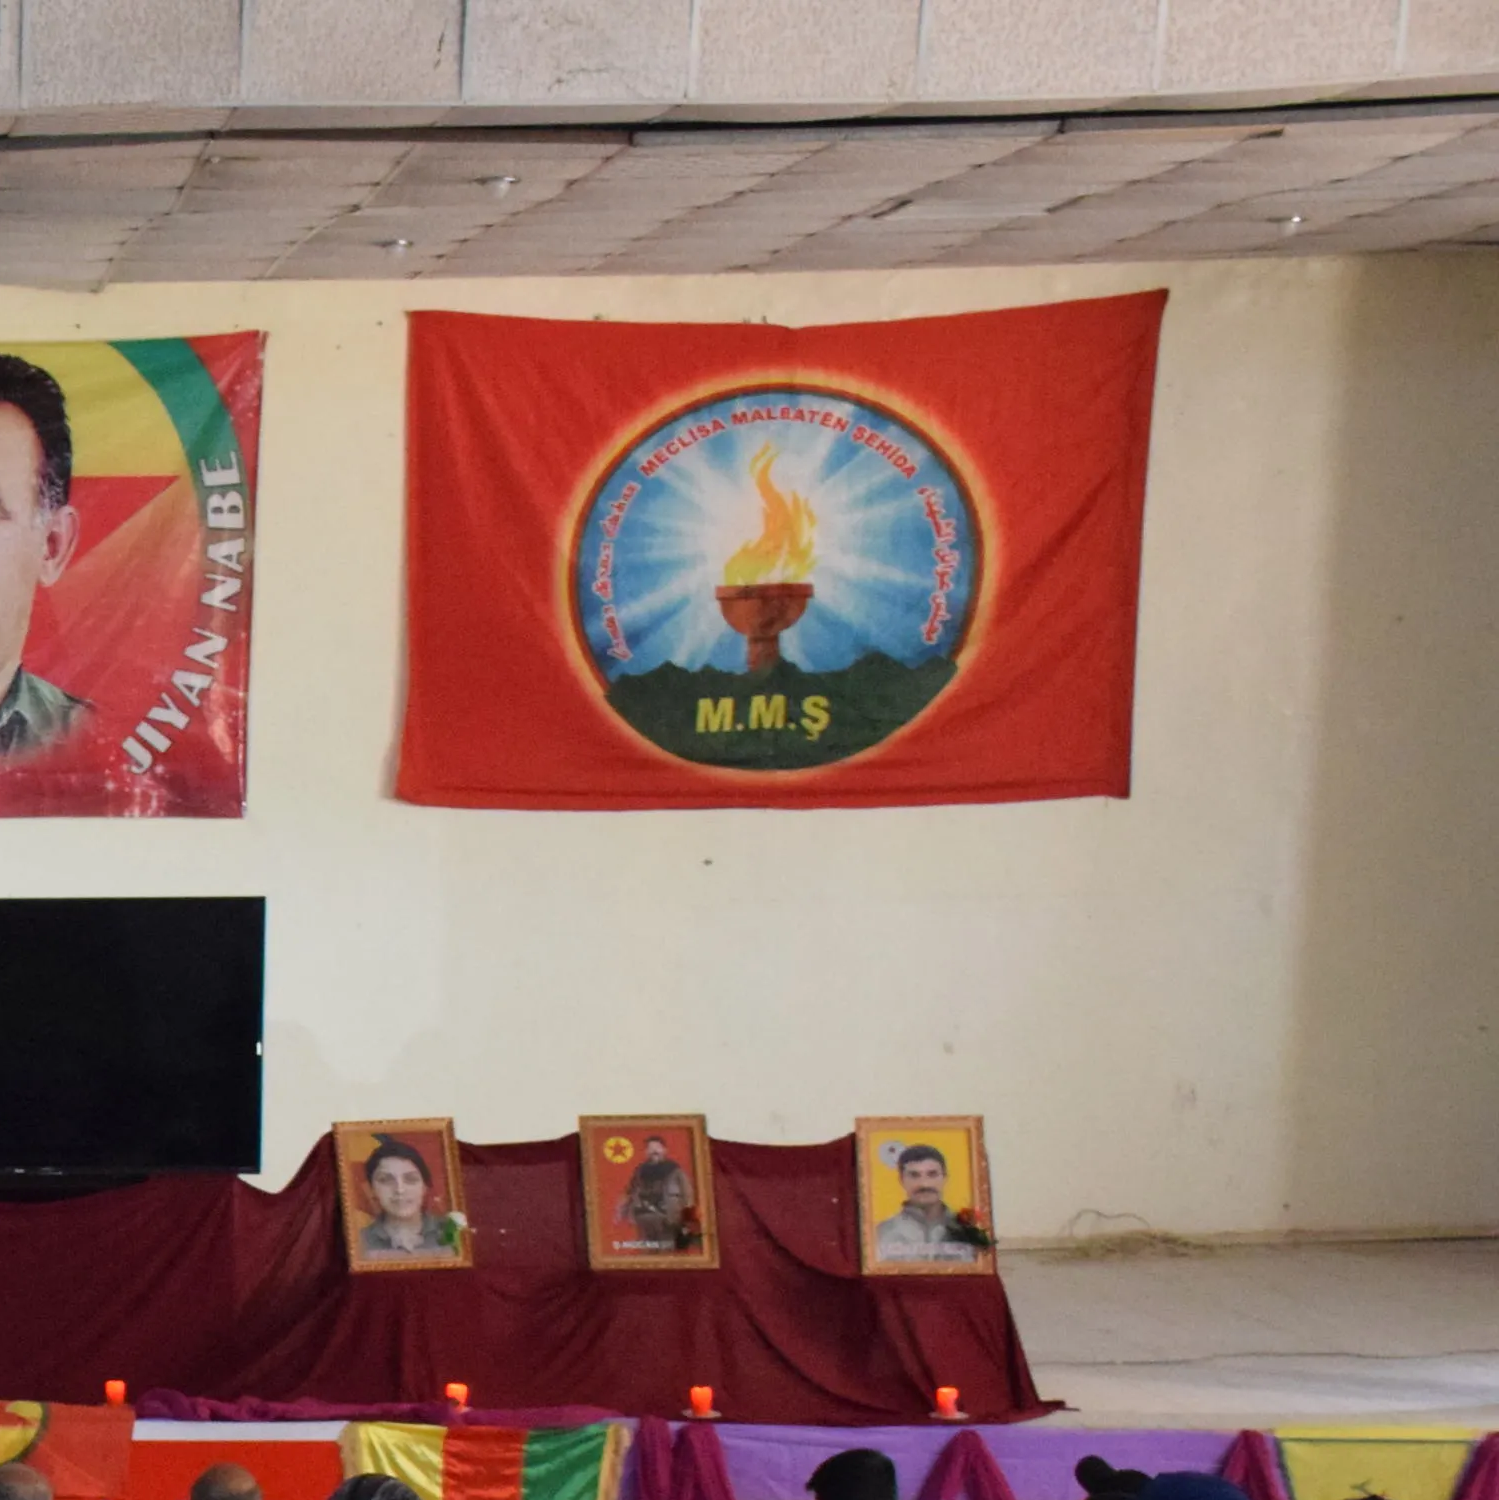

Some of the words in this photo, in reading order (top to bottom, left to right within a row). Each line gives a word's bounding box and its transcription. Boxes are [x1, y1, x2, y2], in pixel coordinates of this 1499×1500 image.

[121, 626, 228, 775] JIYAN
[198, 449, 245, 612] NABE
[695, 693, 832, 742] M.M.Ş
